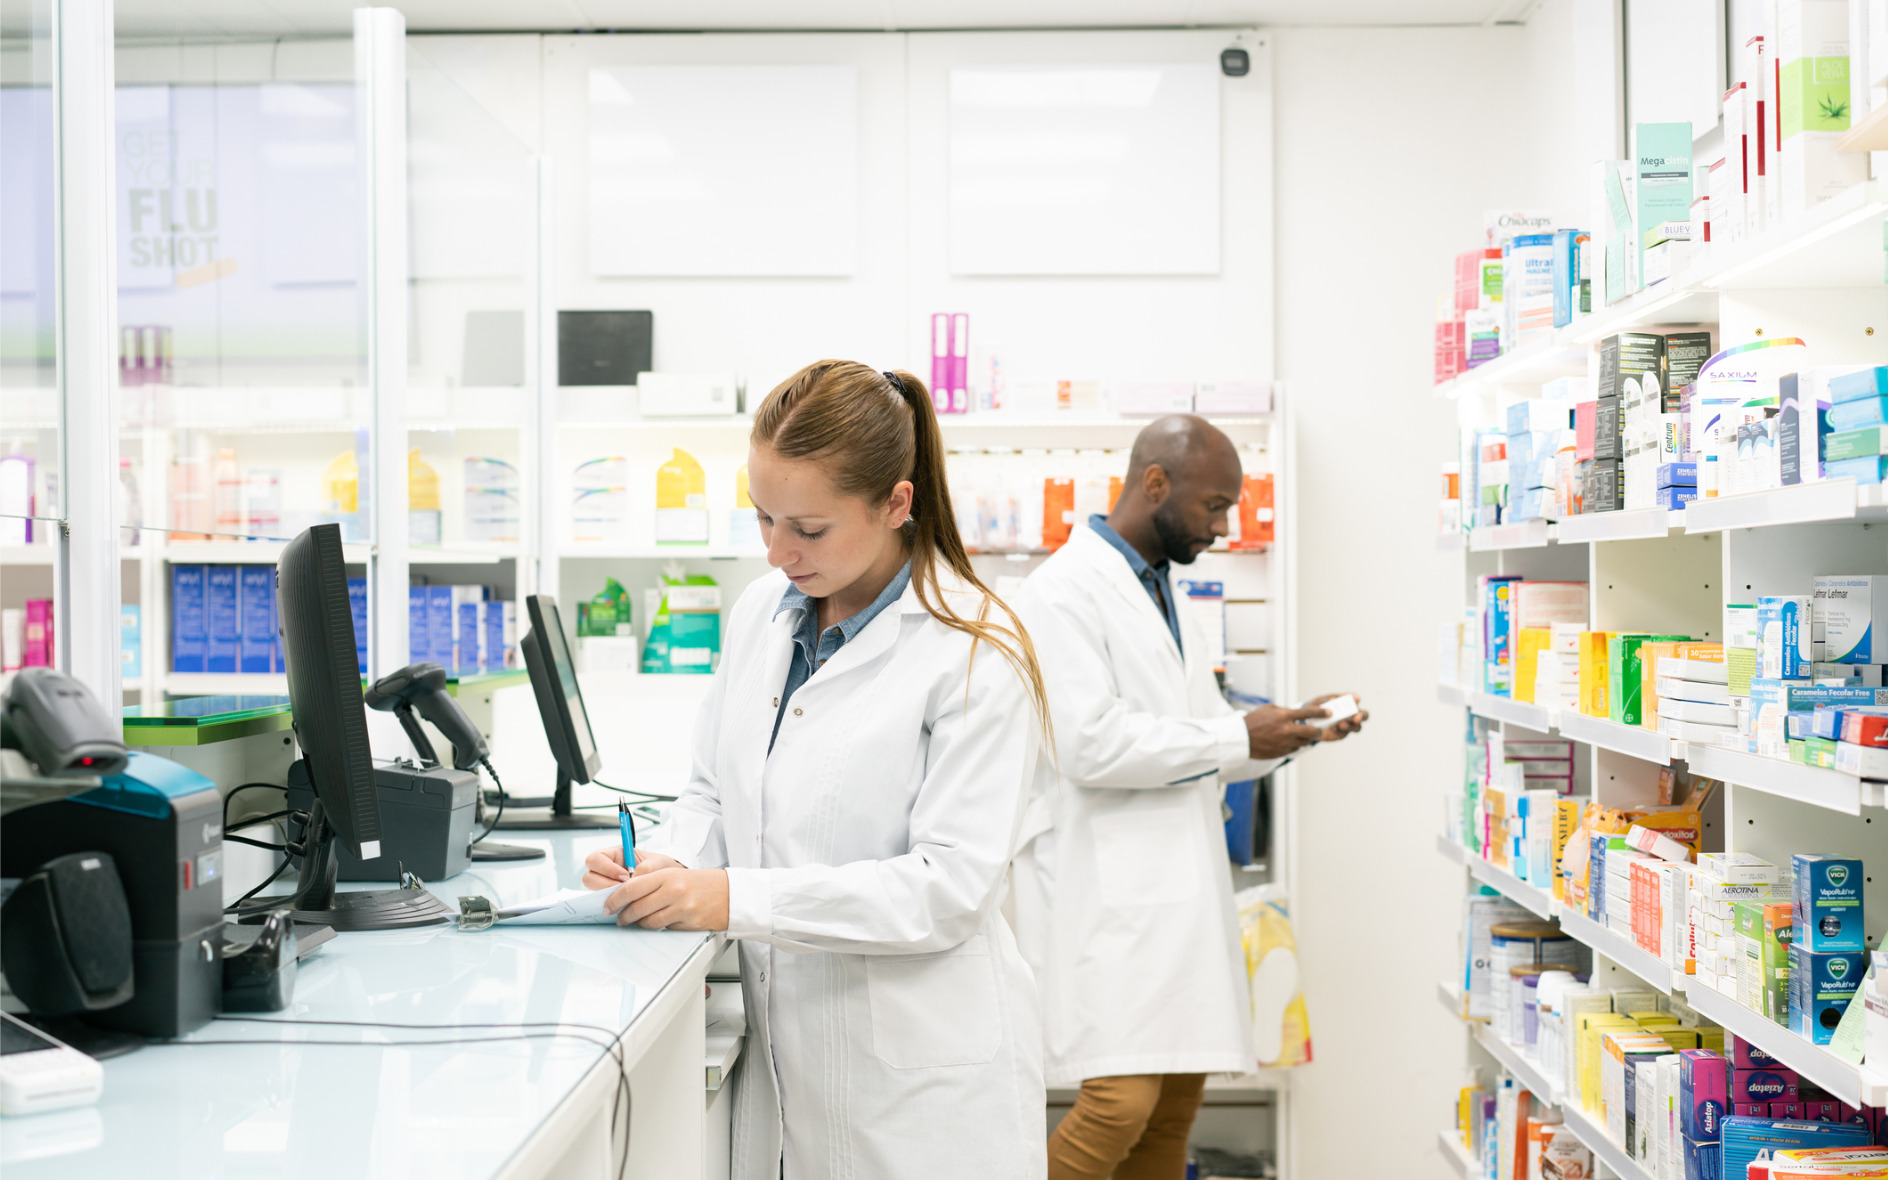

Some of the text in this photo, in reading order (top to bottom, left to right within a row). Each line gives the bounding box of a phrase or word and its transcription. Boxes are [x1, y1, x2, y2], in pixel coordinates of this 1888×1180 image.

[122, 130, 183, 158] GET
[125, 158, 216, 186] YOUR
[128, 187, 218, 233] FLU
[129, 236, 219, 268] SHOT
[1709, 370, 1757, 379] SAXIUM
[1664, 422, 1674, 454] Centrum
[1827, 588, 1848, 599] Lefmar
[1791, 688, 1870, 697] Caramelos Fecofar Free
[1721, 886, 1759, 894] AEROTINA
[1820, 888, 1848, 896] VapoRub
[1748, 1084, 1784, 1093] Aziatop
[1704, 1100, 1714, 1134] Aziatop
